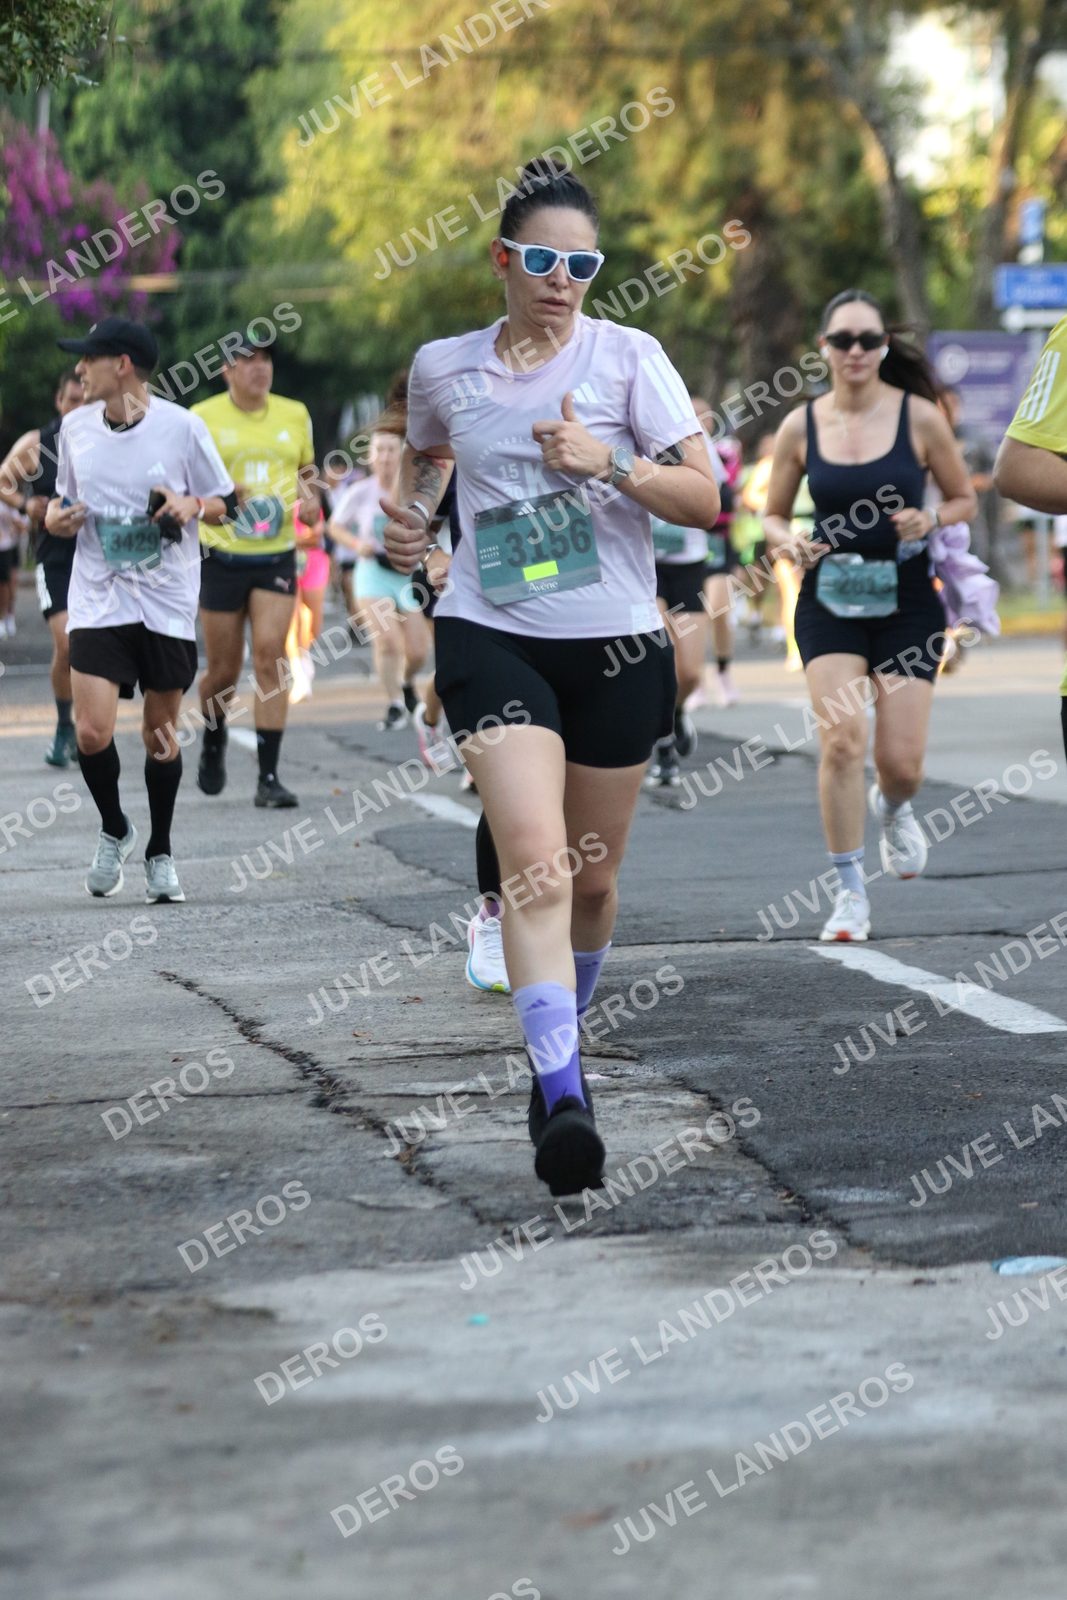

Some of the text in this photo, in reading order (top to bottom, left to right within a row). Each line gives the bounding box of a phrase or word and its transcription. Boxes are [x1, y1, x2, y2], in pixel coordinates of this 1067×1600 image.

[498, 463, 519, 480] 15
[110, 531, 159, 553] 3429
[505, 518, 592, 568] 3156
